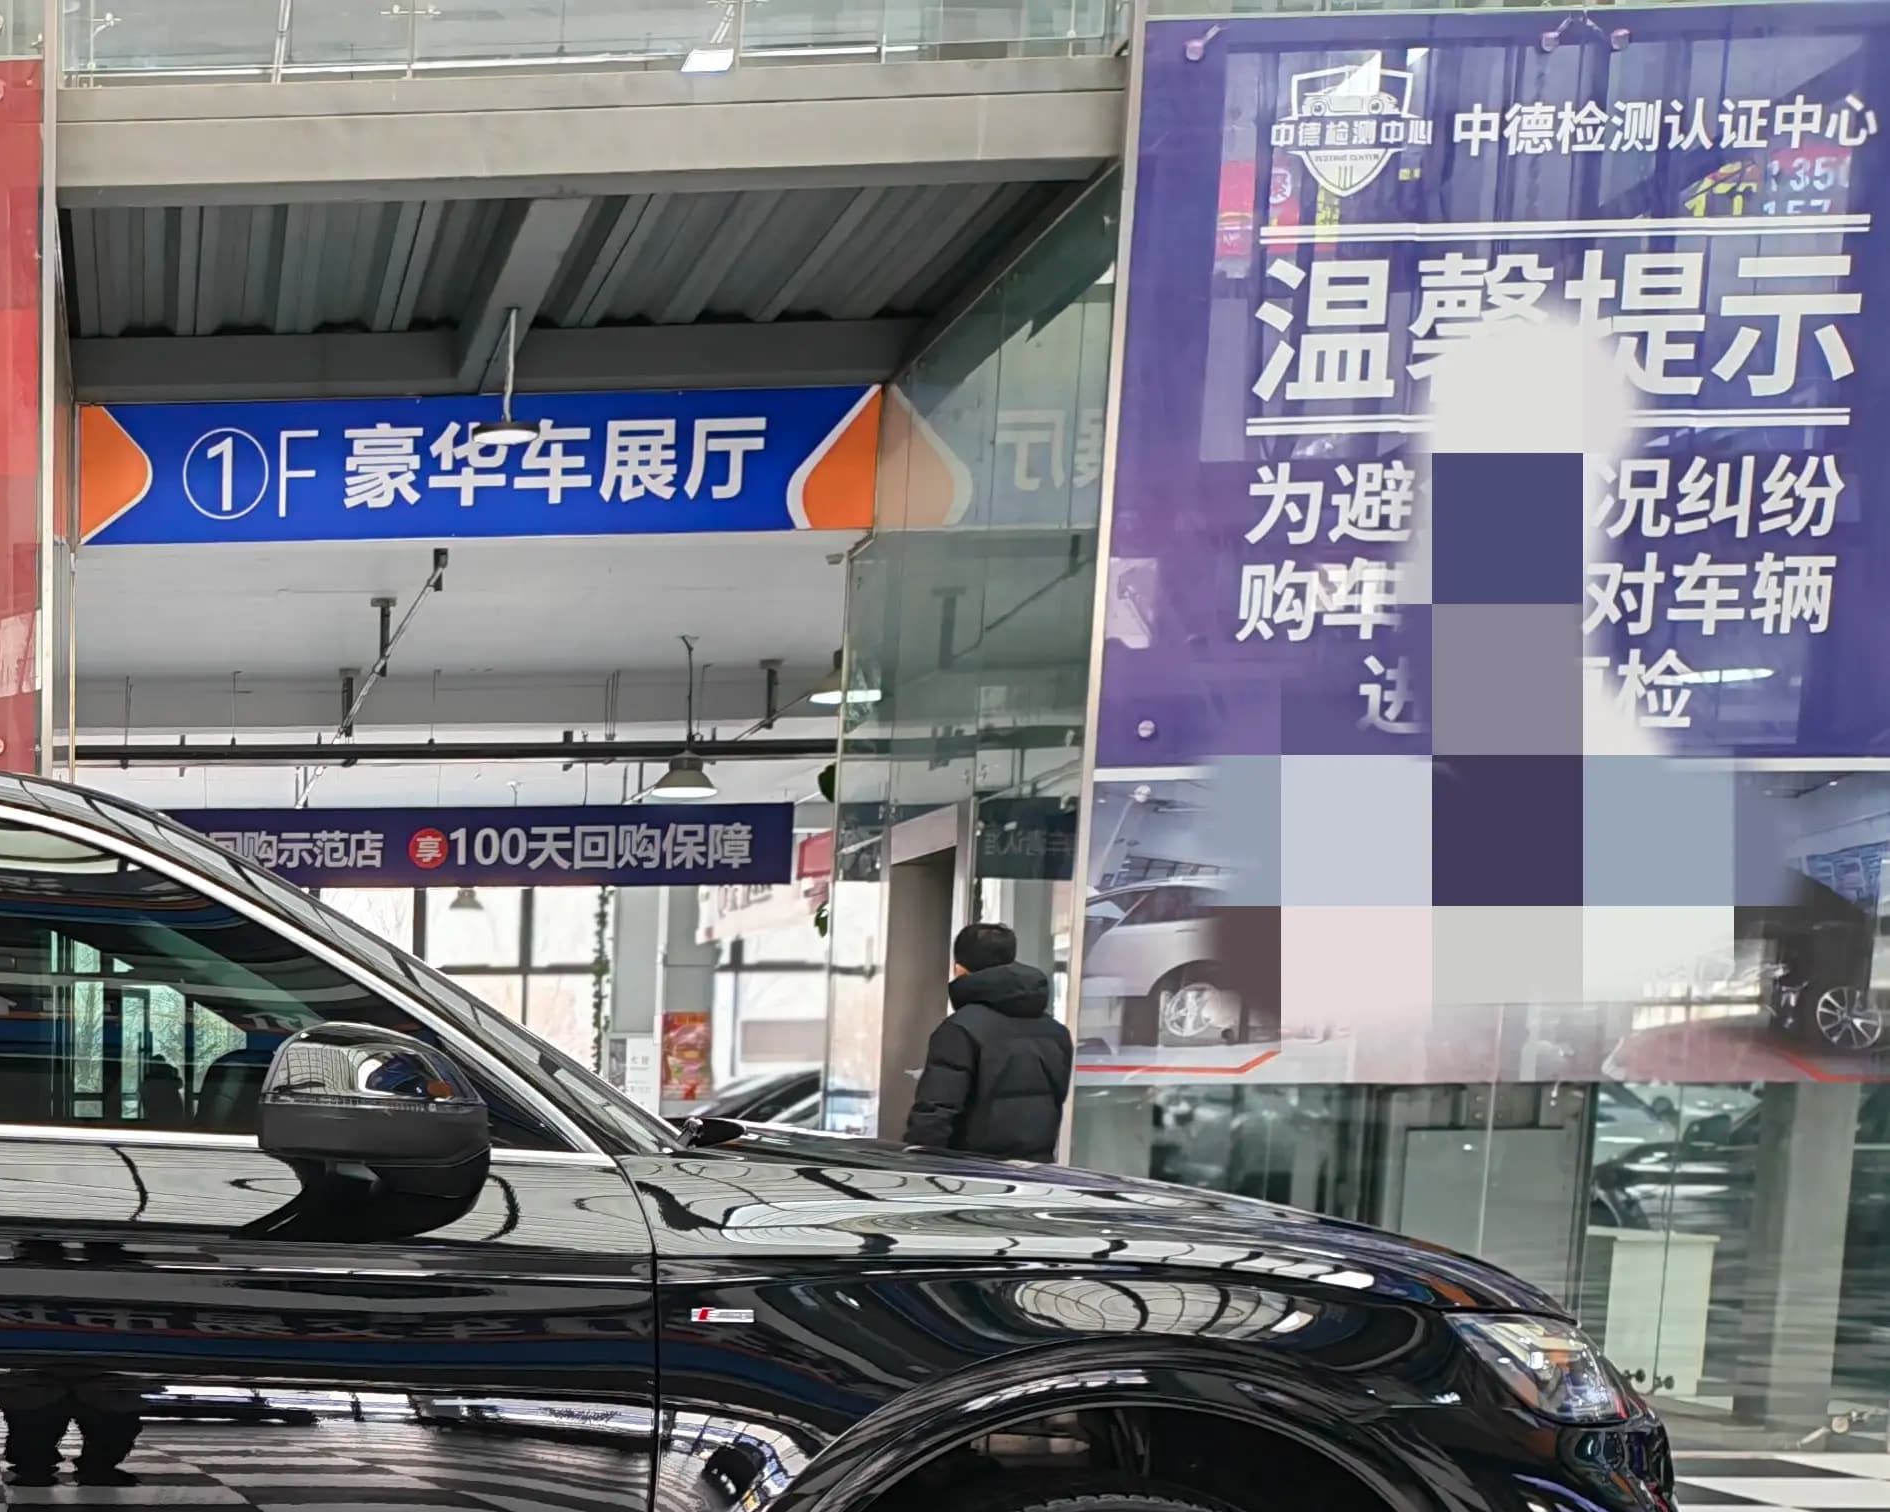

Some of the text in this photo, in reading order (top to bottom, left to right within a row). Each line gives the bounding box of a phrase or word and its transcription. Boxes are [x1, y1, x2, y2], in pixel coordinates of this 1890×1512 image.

[1453, 94, 1877, 156] 中德检测认证中心
[344, 416, 767, 508] 豪华车展厅
[202, 831, 384, 869] 回购示范店
[449, 822, 752, 872] 100天回购保障
